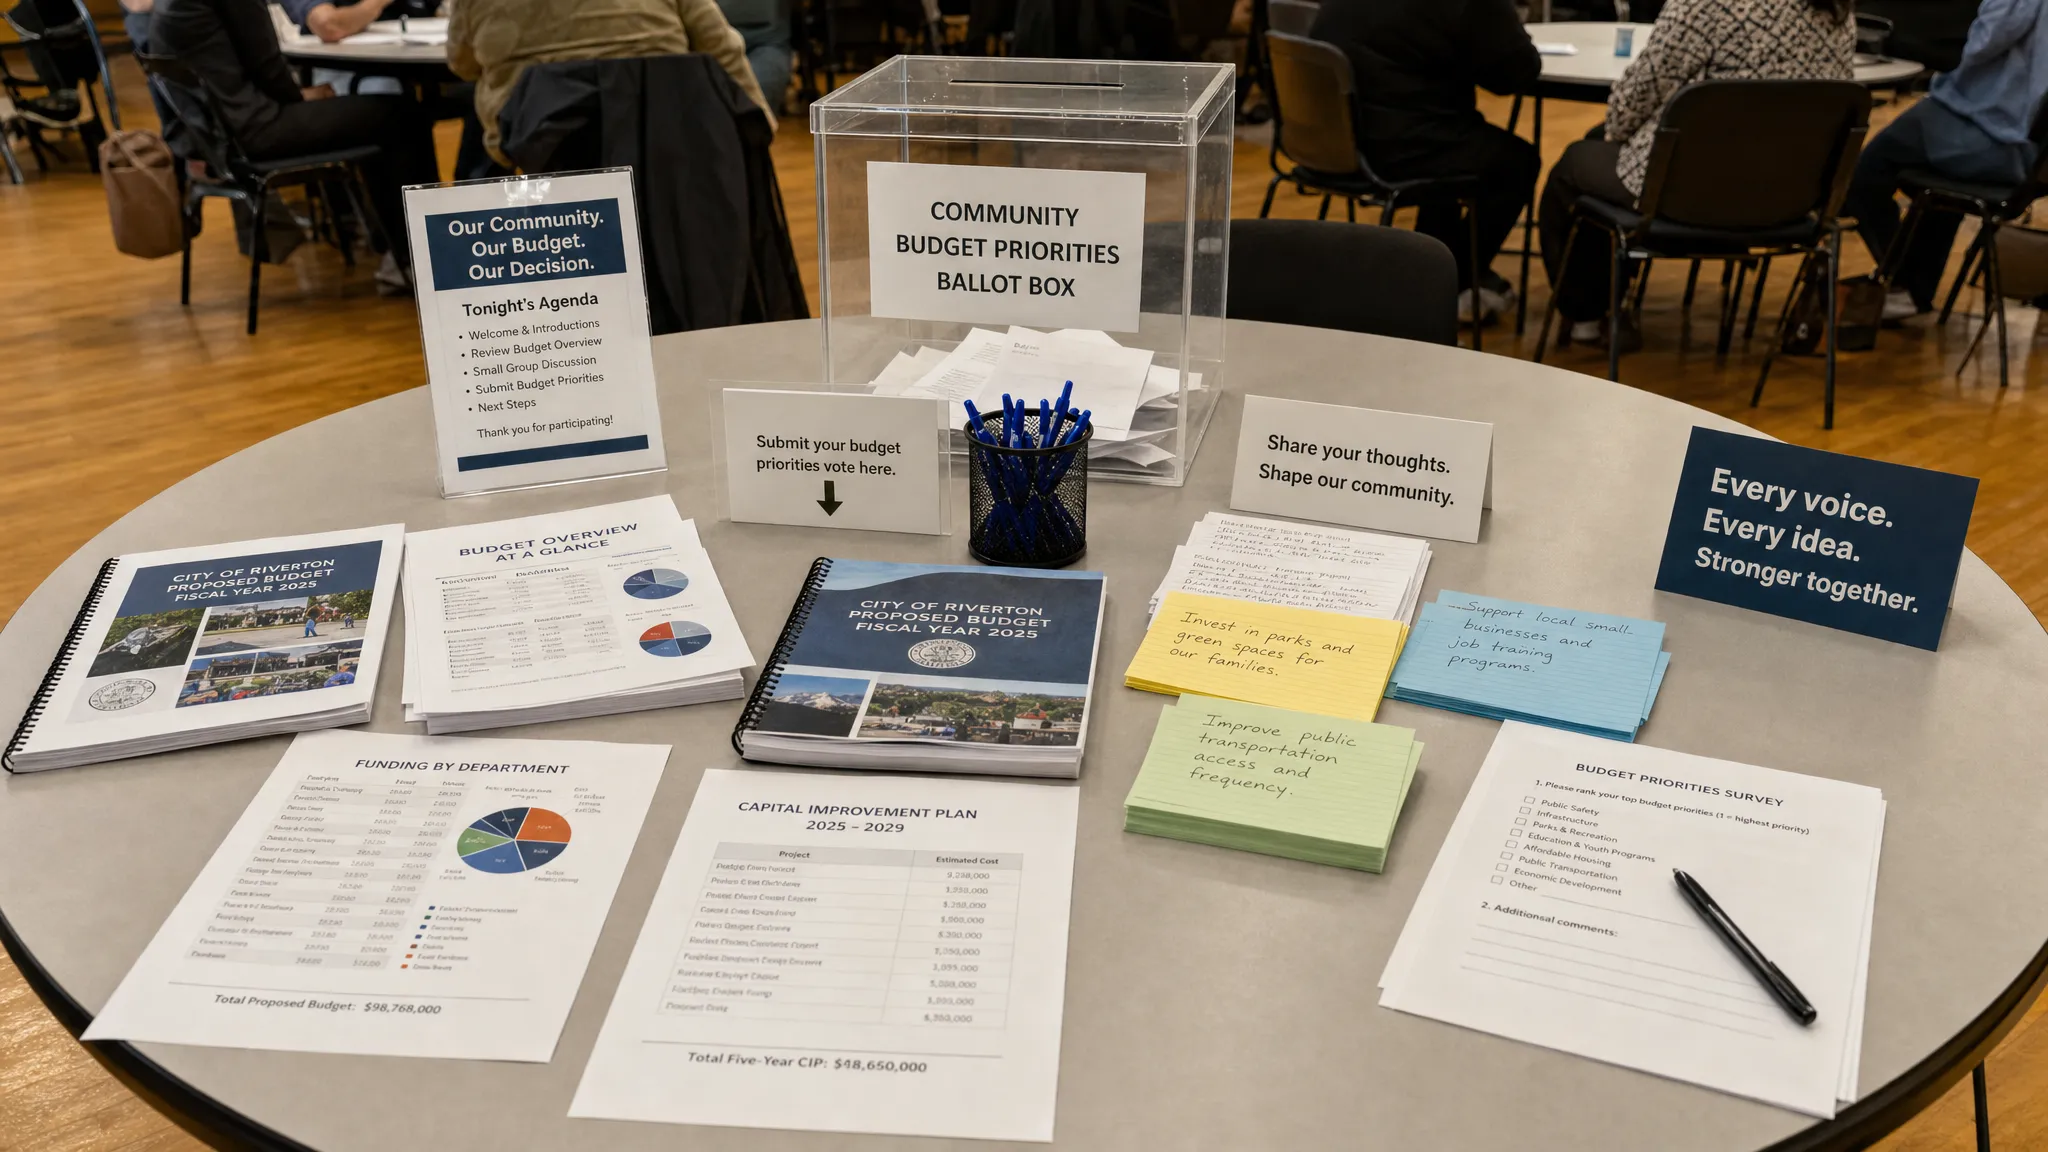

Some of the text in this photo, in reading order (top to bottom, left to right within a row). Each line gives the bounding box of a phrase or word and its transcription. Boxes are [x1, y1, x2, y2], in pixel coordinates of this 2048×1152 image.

[448, 210, 604, 237] Our Community.
[931, 201, 1079, 227] COMMUNITY
[472, 234, 585, 257] Our Budget.
[896, 235, 1120, 264] BUDGET PRIORITIES
[469, 256, 594, 280] Our Decision.
[938, 272, 1075, 296] BALLOT BOX
[462, 293, 598, 316] Tonight's Agenda
[469, 319, 599, 340] Welcome & Introductions
[471, 337, 602, 359] Review Budget Overview
[473, 356, 597, 376] Small Group Discussion
[476, 373, 604, 394] Submit Budget Priorities
[478, 398, 536, 413] Next Steps
[477, 416, 613, 438] Thank you for participating!
[757, 435, 901, 456] Submit your budget
[1267, 434, 1451, 474] Share your thoughts.
[757, 457, 896, 475] priorities vote here.
[1259, 464, 1454, 508] Shape our community.
[1710, 467, 1893, 528] Every voice.
[459, 522, 638, 556] BUDGET OVERVIEW
[1703, 507, 1860, 562] Every idea.
[496, 539, 610, 562] AT A GLANCE
[167, 569, 334, 593] PROPOSED BUDGET
[173, 558, 335, 583] CITY OF RIVERTON
[1695, 547, 1918, 613] Stronger together.
[175, 580, 317, 601] FISCAL YEAR 2025
[849, 611, 1051, 627] PROPOSED BUDGET
[860, 600, 1042, 615] CITY OF RIVERTON
[1467, 601, 1524, 619] Support
[1535, 611, 1576, 626] local
[856, 622, 1038, 638] FISCAL YEAR 2025
[1180, 611, 1355, 655] Invest in parks and
[1464, 619, 1593, 648] businesses and
[1173, 630, 1324, 666] green spaces for
[1447, 636, 1553, 664] job training
[1169, 650, 1279, 677] our families.
[1447, 654, 1535, 673] programs.
[1201, 714, 1357, 749] Improve public
[1198, 732, 1338, 766] transportation
[355, 759, 570, 774] FUNDING BY DEPARTMENT
[1193, 752, 1310, 778] access and
[1189, 766, 1294, 799] frequency.
[1575, 762, 1784, 807] BUDGET PRIORITIES SURVEY
[738, 802, 977, 819] CAPITAL IMPROVEMENT PLAN
[1537, 810, 1599, 828] Infrastructure
[1541, 798, 1600, 816] Public Safety
[1545, 781, 1574, 793] Please
[1575, 786, 1595, 795] rank
[1598, 790, 1619, 801] your
[1621, 795, 1637, 804] top
[1639, 797, 1672, 810] budget
[1673, 804, 1714, 818] priorities
[1735, 816, 1769, 828] highest
[1772, 823, 1810, 836] priority)
[806, 820, 846, 831] 2025
[864, 822, 904, 833] 2029
[1533, 820, 1557, 831] Parks
[1569, 828, 1618, 843] Recreation
[779, 850, 810, 859] Project
[936, 856, 977, 864] Estimated
[1523, 843, 1612, 868] Affordable Housing
[1528, 832, 1571, 846] Education
[1583, 843, 1609, 854] Youth
[1612, 848, 1656, 864] Programs
[1518, 855, 1618, 881] Public Transportation
[1509, 879, 1538, 893] Other
[1514, 867, 1622, 896] Economic Development
[1481, 901, 1490, 909] 2.
[1556, 917, 1618, 937] comments:
[214, 995, 442, 1015] Total Proposed Budget: $98,768,000
[688, 1052, 723, 1064] Total
[727, 1054, 793, 1068] Five-Year
[798, 1056, 828, 1069] CIP:
